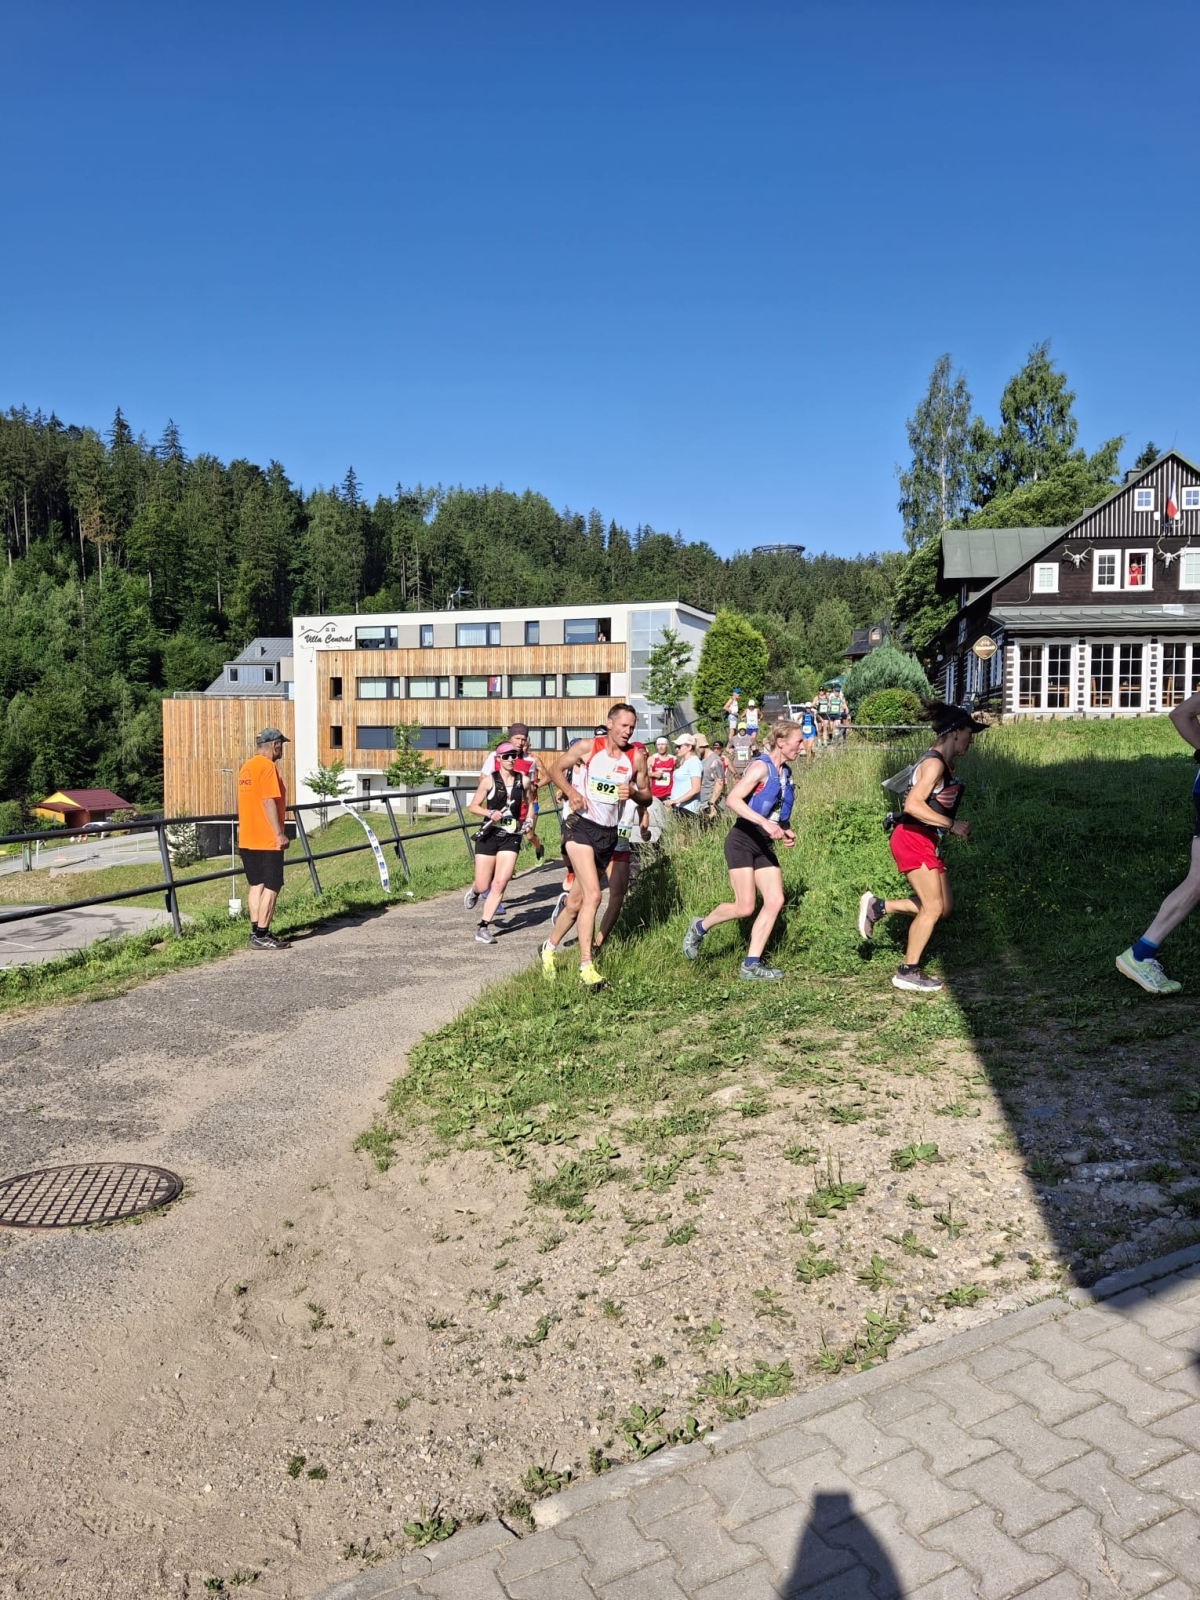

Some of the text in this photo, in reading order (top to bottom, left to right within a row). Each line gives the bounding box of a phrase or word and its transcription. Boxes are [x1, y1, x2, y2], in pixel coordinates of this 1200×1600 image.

[304, 633, 353, 644] Villa Central
[596, 782, 616, 794] 892
